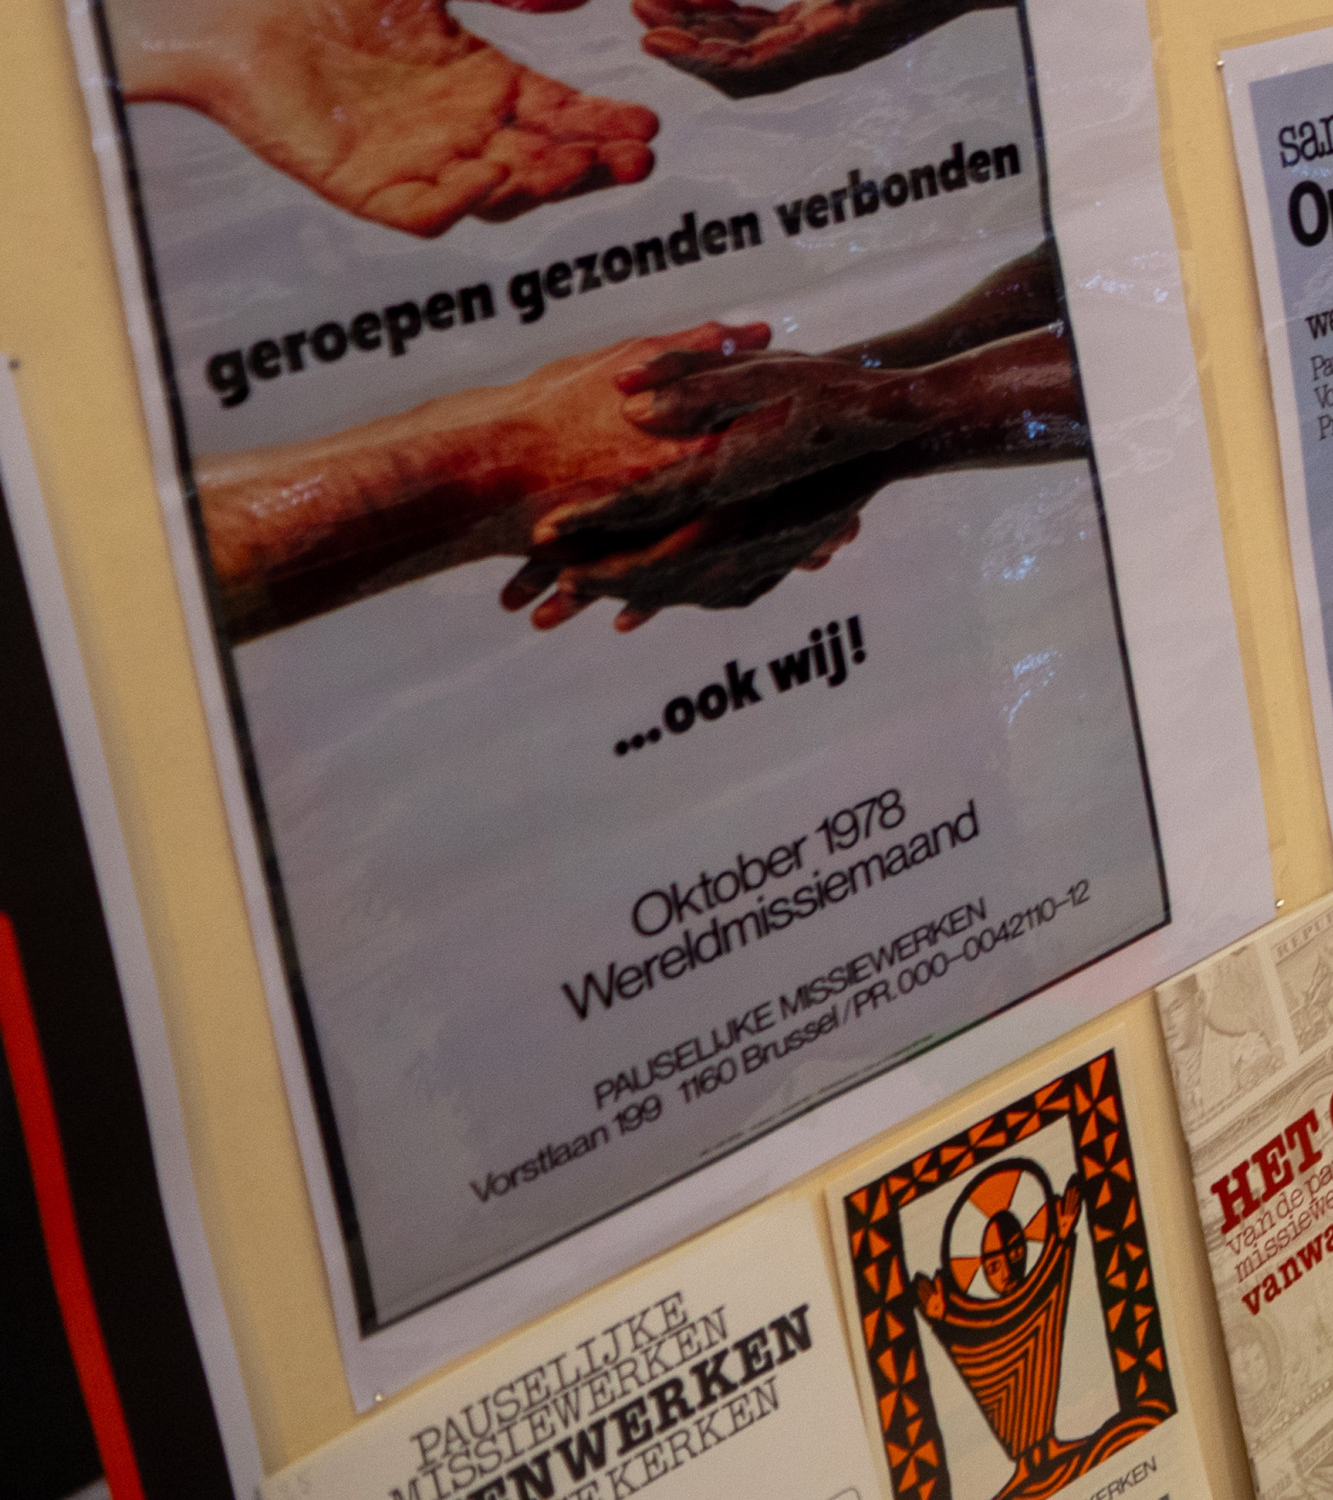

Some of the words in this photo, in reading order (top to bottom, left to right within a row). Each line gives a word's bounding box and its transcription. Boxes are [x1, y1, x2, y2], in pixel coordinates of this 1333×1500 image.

[204, 273, 498, 408] geroepen
[505, 204, 765, 324] gezonden
[773, 137, 1022, 238] verbonden
[767, 614, 869, 692] wij!
[561, 800, 981, 1020] Wereldmissiemaand
[630, 834, 808, 941] Oktober
[817, 787, 906, 853] 1978
[592, 1004, 776, 1110] PAUSELIJKE
[778, 897, 989, 1018] MISSIEWERKEN
[1209, 1120, 1323, 1234] HET
[1226, 1208, 1272, 1255] van
[1274, 1188, 1305, 1224] de
[410, 1291, 689, 1472] PAUSELIJKE
[606, 1375, 782, 1500] KERKEN
